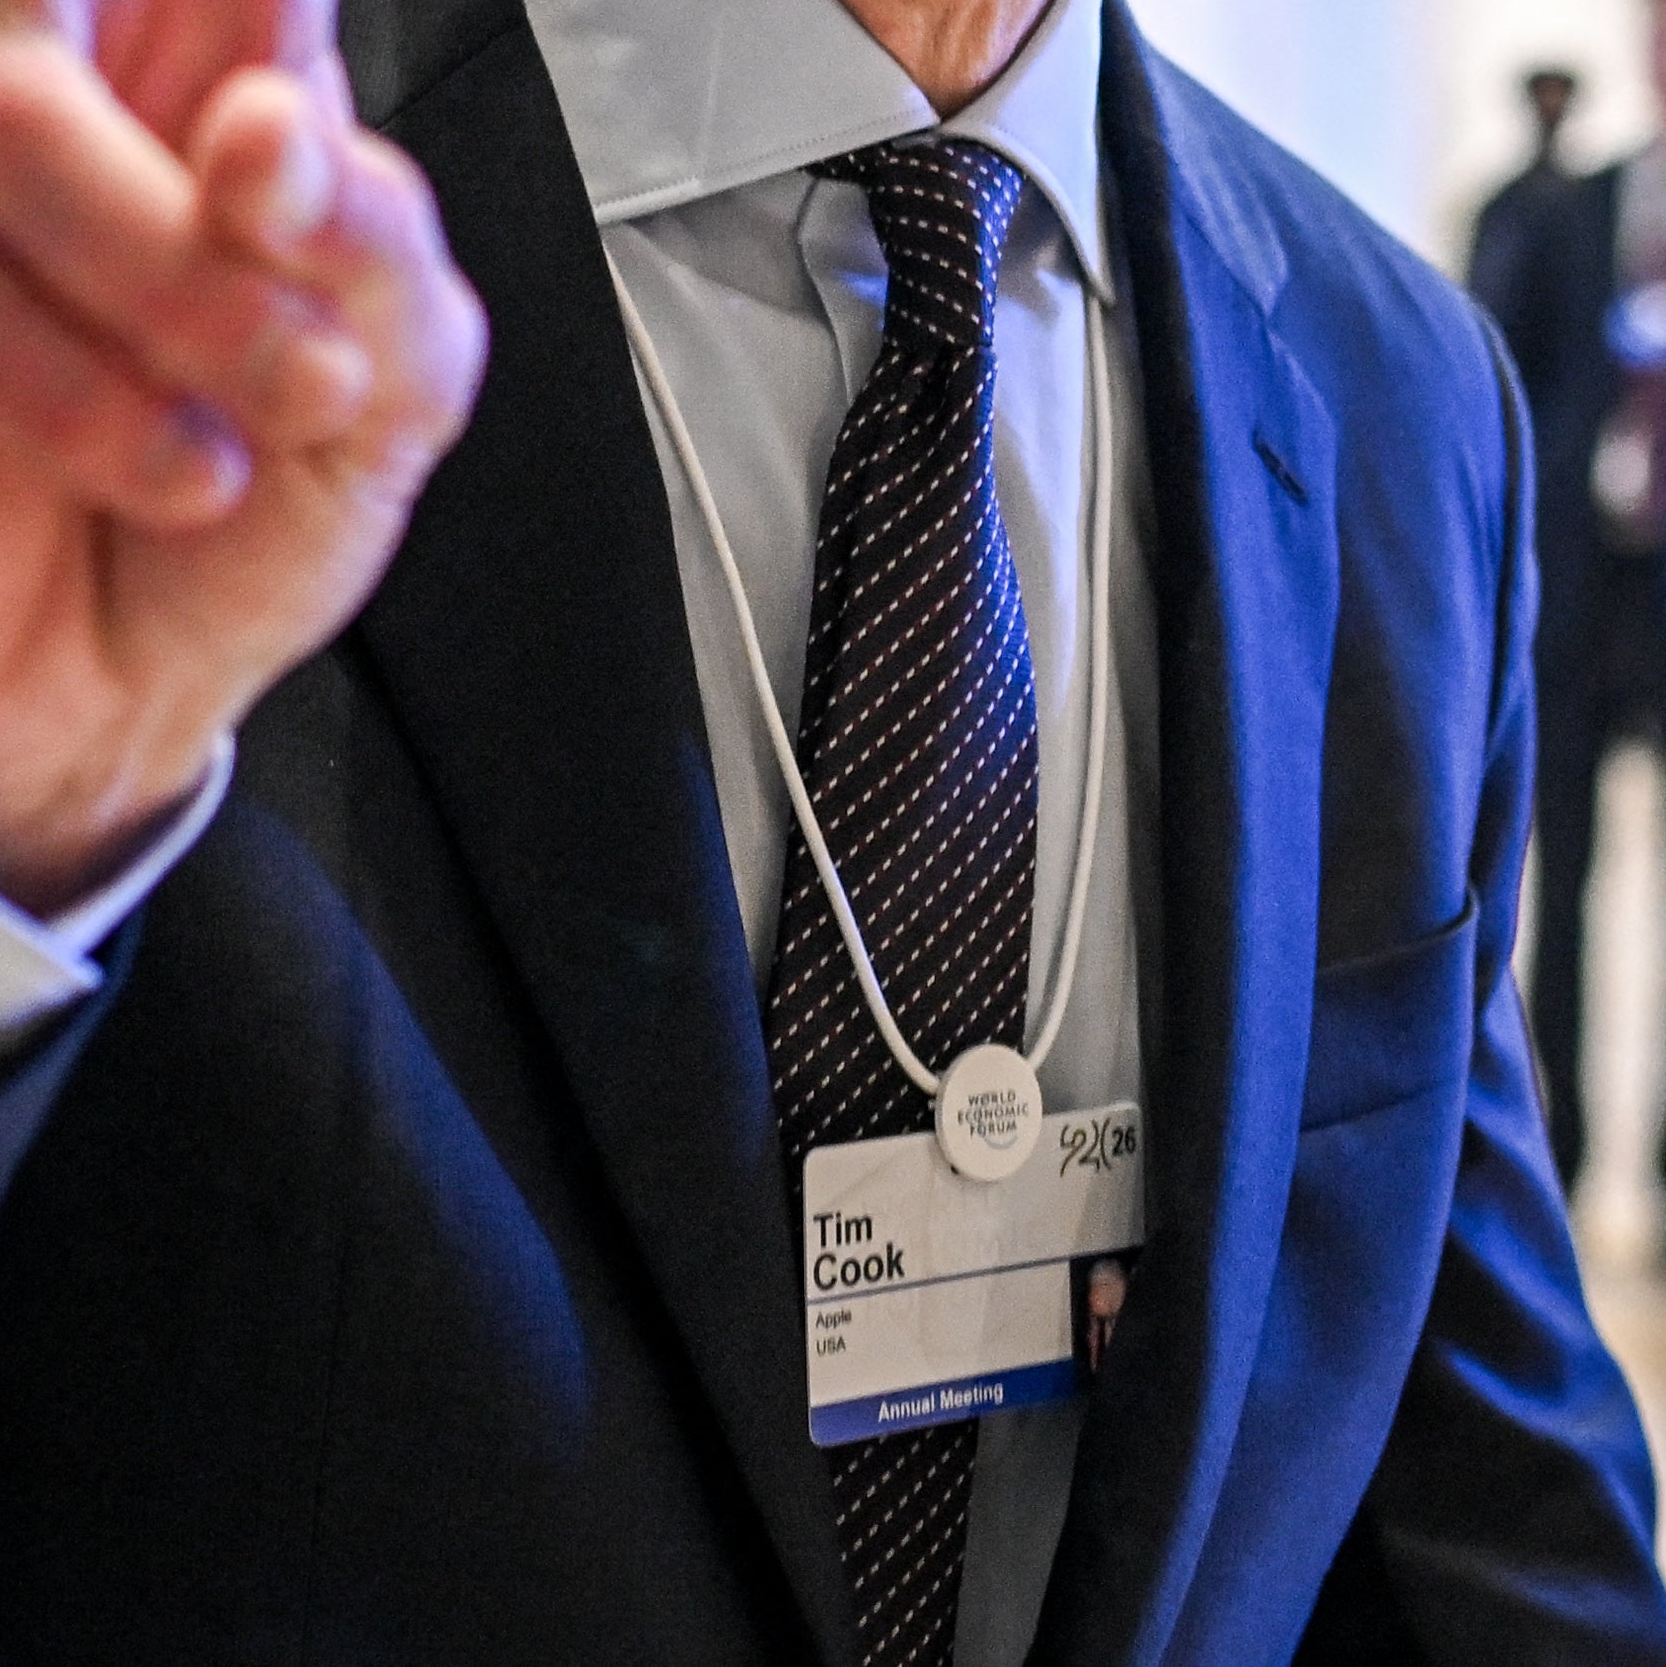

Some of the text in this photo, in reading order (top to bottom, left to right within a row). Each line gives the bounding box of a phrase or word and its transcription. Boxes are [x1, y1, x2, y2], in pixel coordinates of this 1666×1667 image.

[968, 1090, 1016, 1106] WORLD
[958, 1103, 1029, 1125] ECONOMIC
[970, 1121, 1017, 1138] FORUM
[812, 1210, 872, 1248] Tim
[813, 1242, 905, 1290] Cook
[815, 1307, 852, 1330] Apple
[816, 1335, 846, 1356] USA
[878, 1382, 1004, 1423] Annual Meeting
